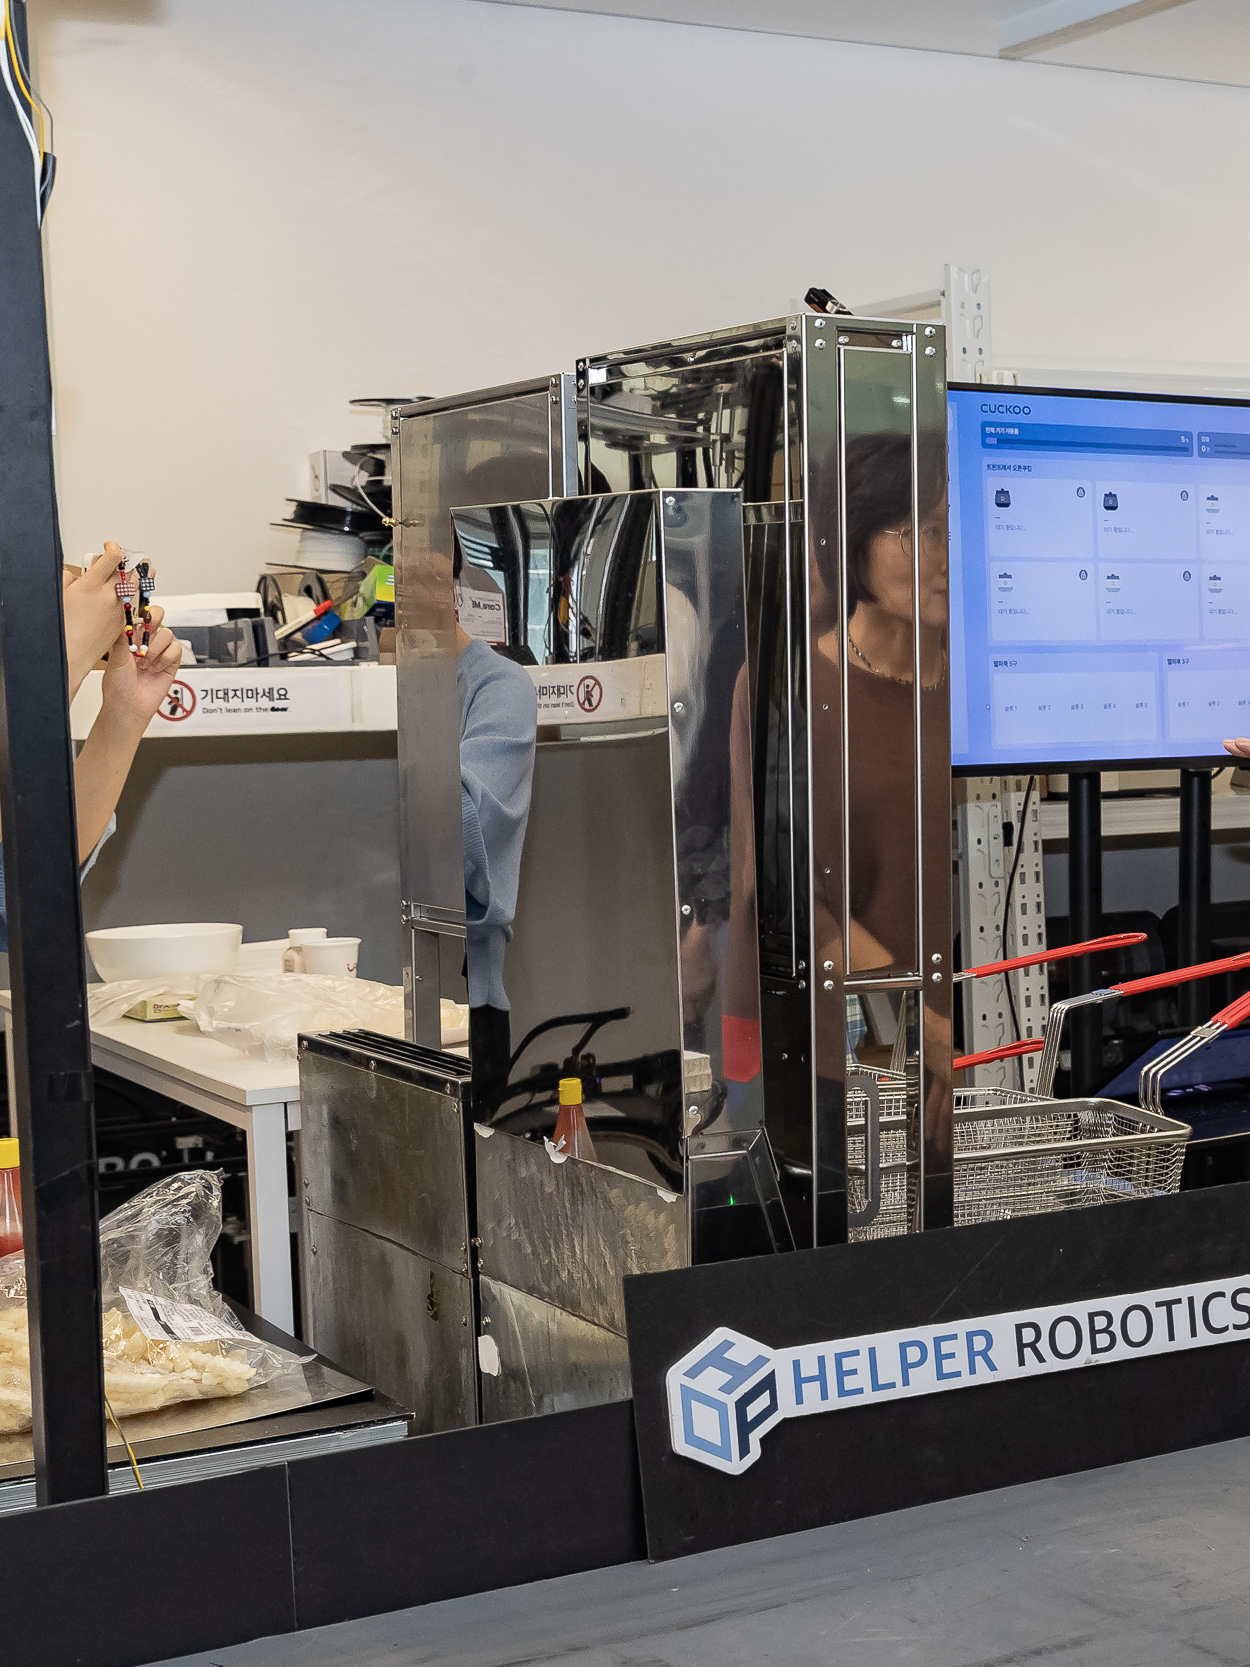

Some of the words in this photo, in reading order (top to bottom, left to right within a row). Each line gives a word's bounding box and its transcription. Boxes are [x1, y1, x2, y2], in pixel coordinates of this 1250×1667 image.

[980, 403, 1032, 416] CUCKOO
[200, 687, 291, 703] 기대지마세요
[792, 1328, 998, 1406] HELPER
